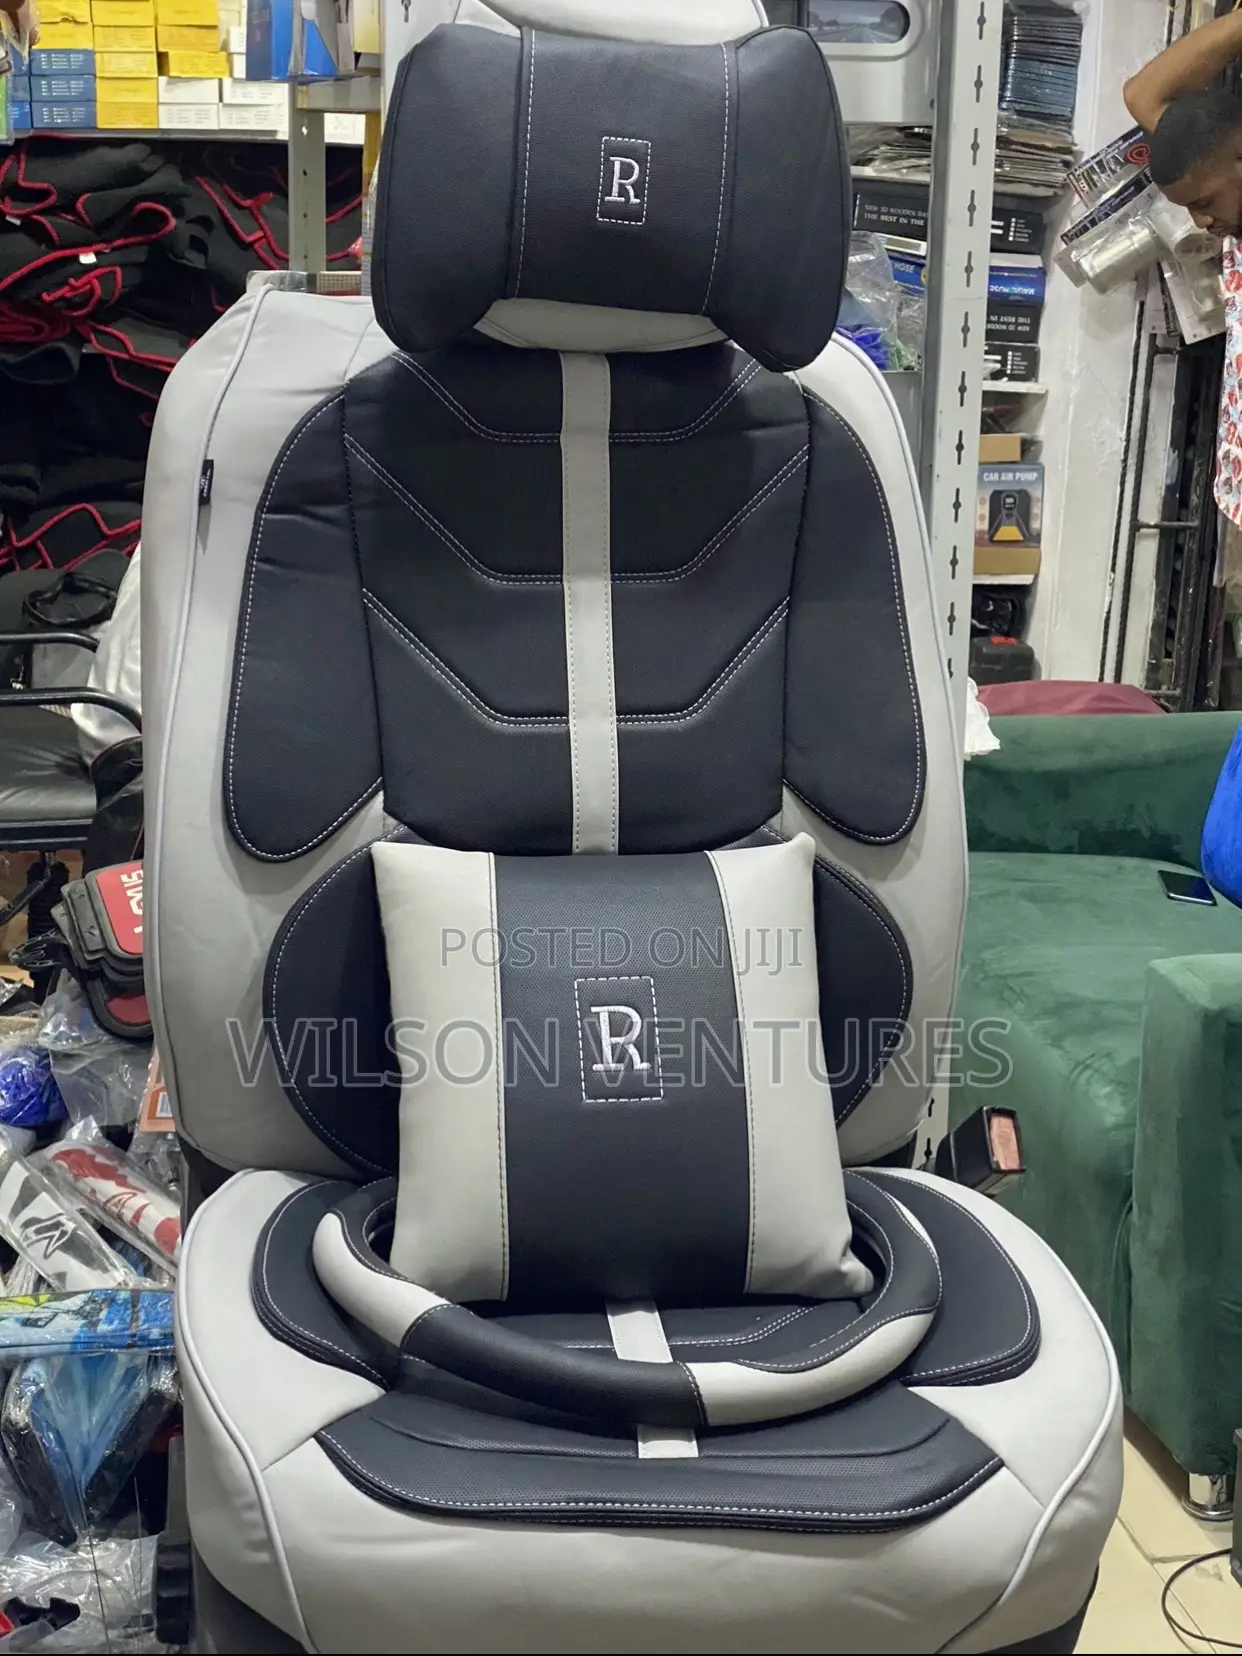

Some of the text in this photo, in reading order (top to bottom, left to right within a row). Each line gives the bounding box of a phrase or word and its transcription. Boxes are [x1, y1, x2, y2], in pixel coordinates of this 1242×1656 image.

[604, 156, 641, 204] R
[880, 214, 898, 223] BEST
[910, 218, 925, 226] THE
[999, 315, 1016, 323] BEST
[983, 471, 1039, 481] CAR AIR PUMP
[590, 1004, 652, 1072] R
